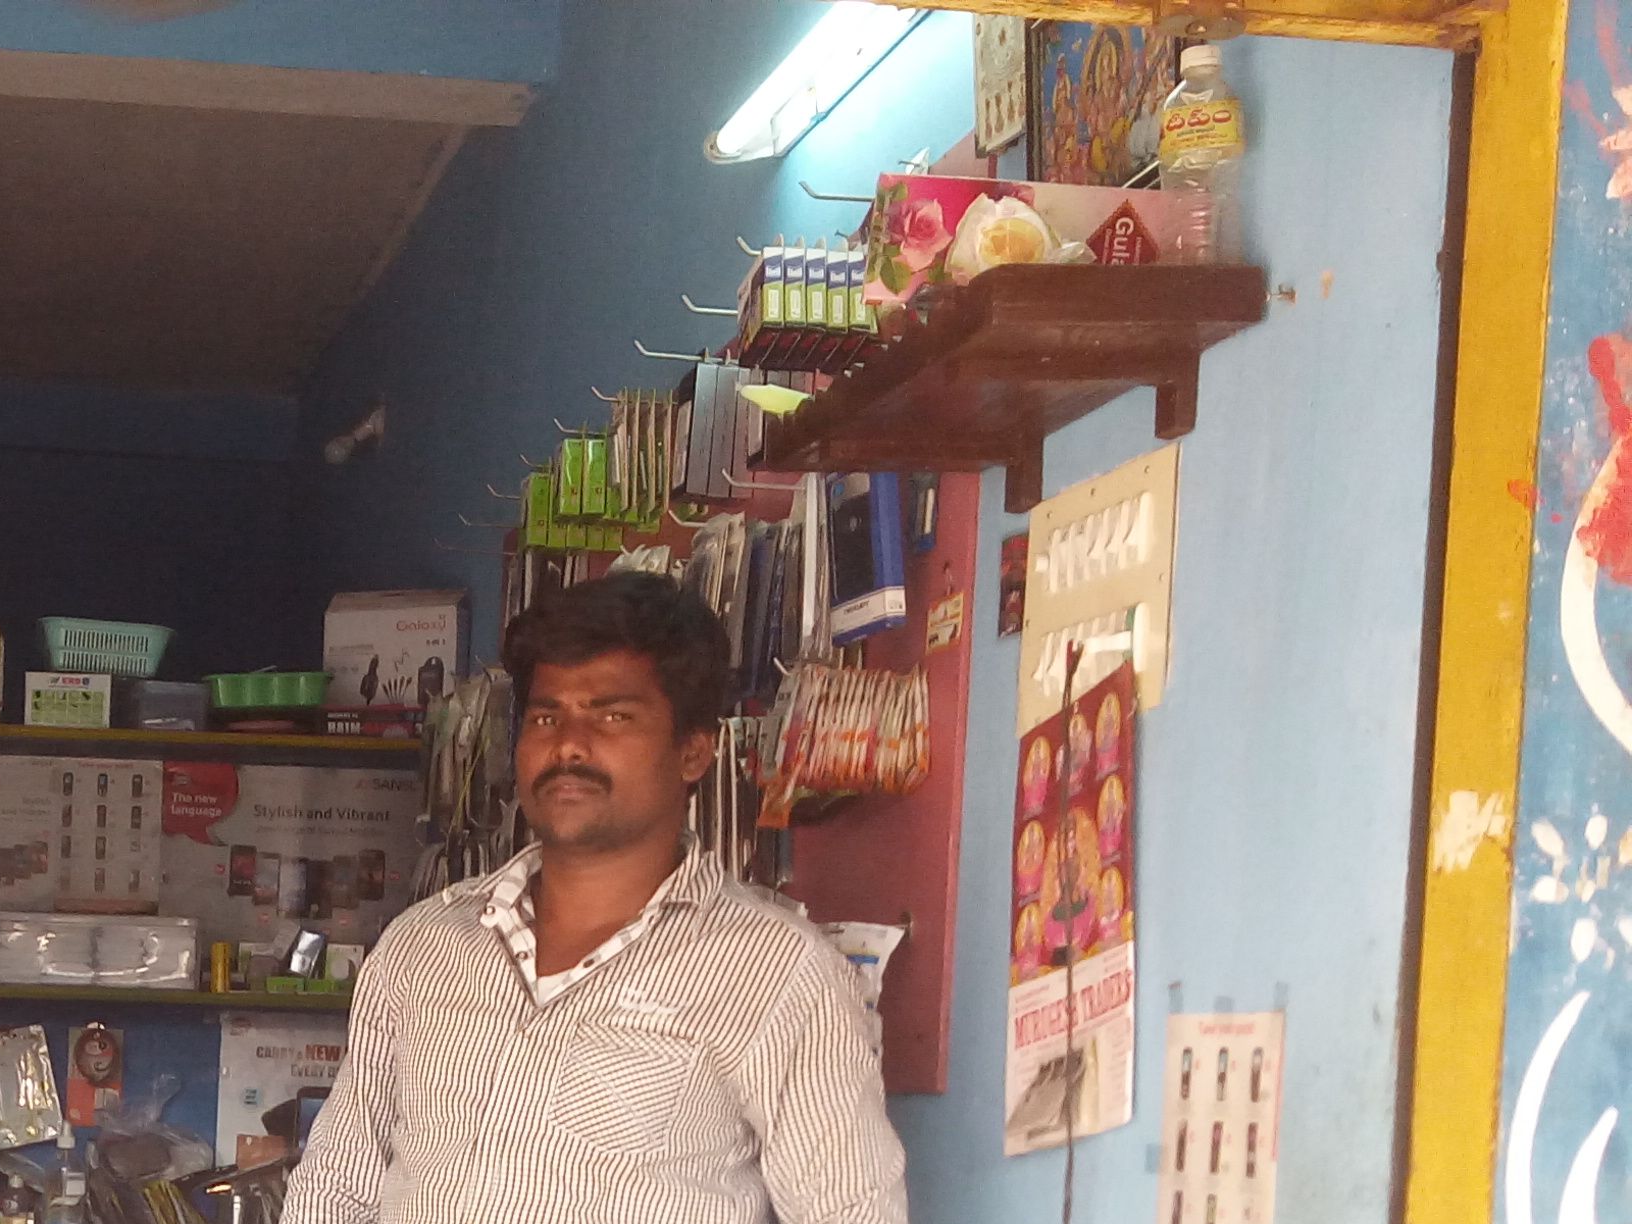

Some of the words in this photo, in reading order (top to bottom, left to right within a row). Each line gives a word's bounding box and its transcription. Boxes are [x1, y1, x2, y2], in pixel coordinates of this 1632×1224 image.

[172, 791, 193, 804] The
[193, 793, 218, 805] new
[171, 803, 222, 819] language
[254, 804, 303, 820] Stylish
[306, 806, 333, 818] and
[335, 806, 390, 820] Vibrant
[305, 1043, 342, 1062] NEW
